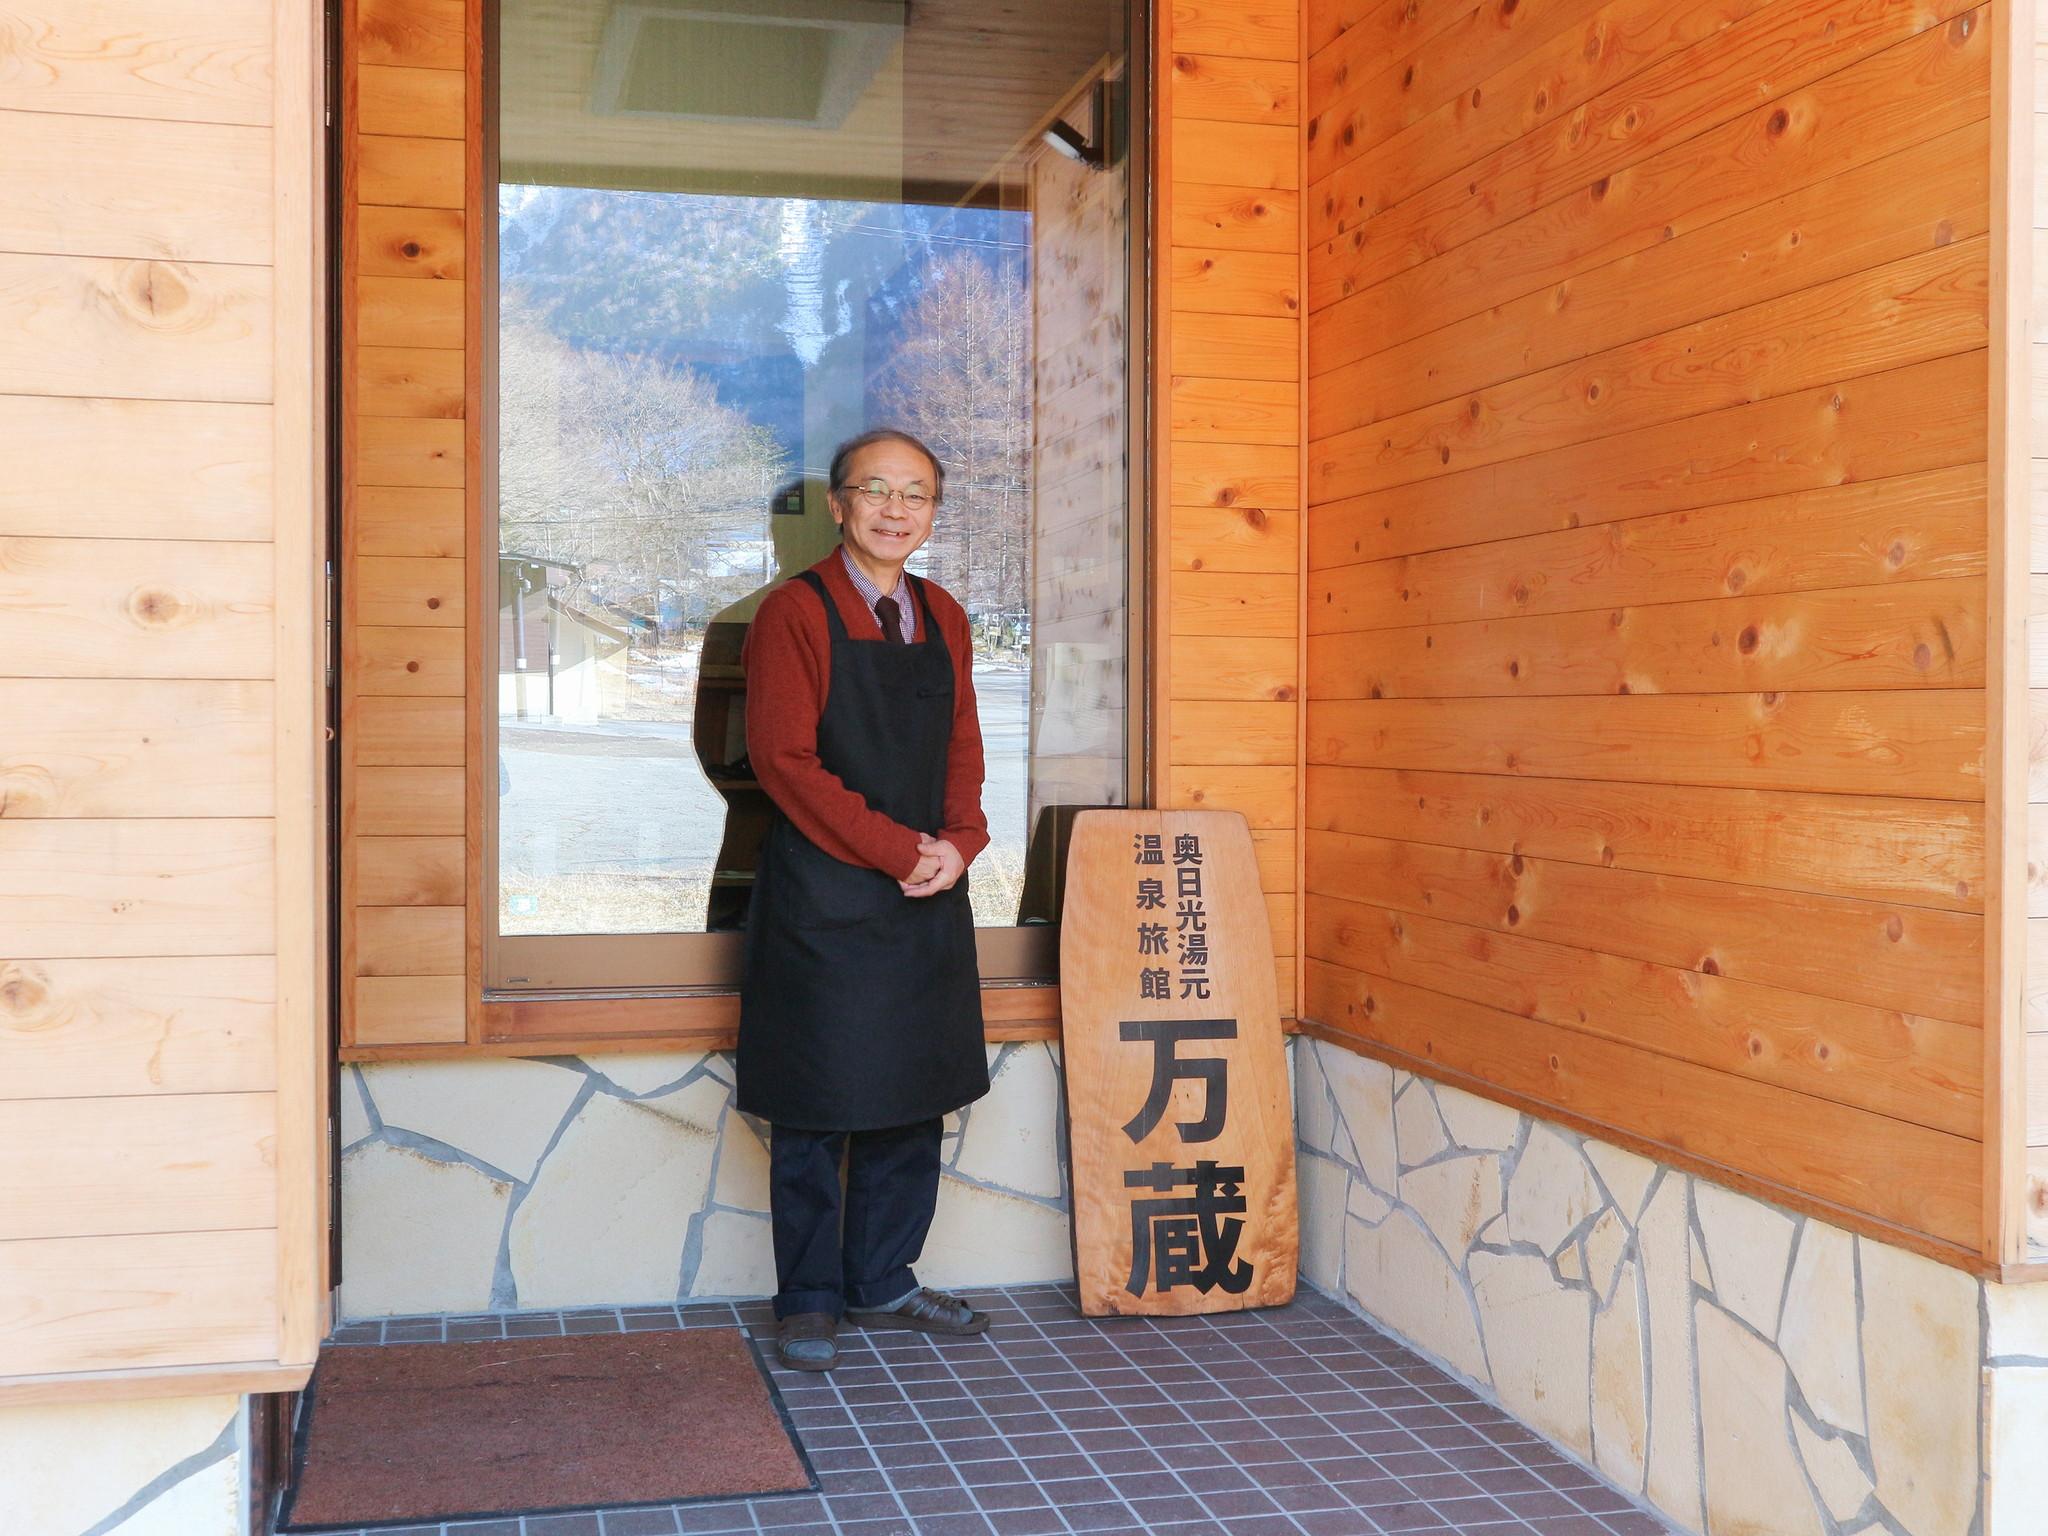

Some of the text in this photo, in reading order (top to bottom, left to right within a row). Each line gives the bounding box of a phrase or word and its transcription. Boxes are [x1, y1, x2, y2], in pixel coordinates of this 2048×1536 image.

[1133, 833, 1170, 1000] 温泉旅館
[1172, 833, 1211, 1000] 奥日光湯元
[1119, 1018, 1254, 1298] 万蔵
